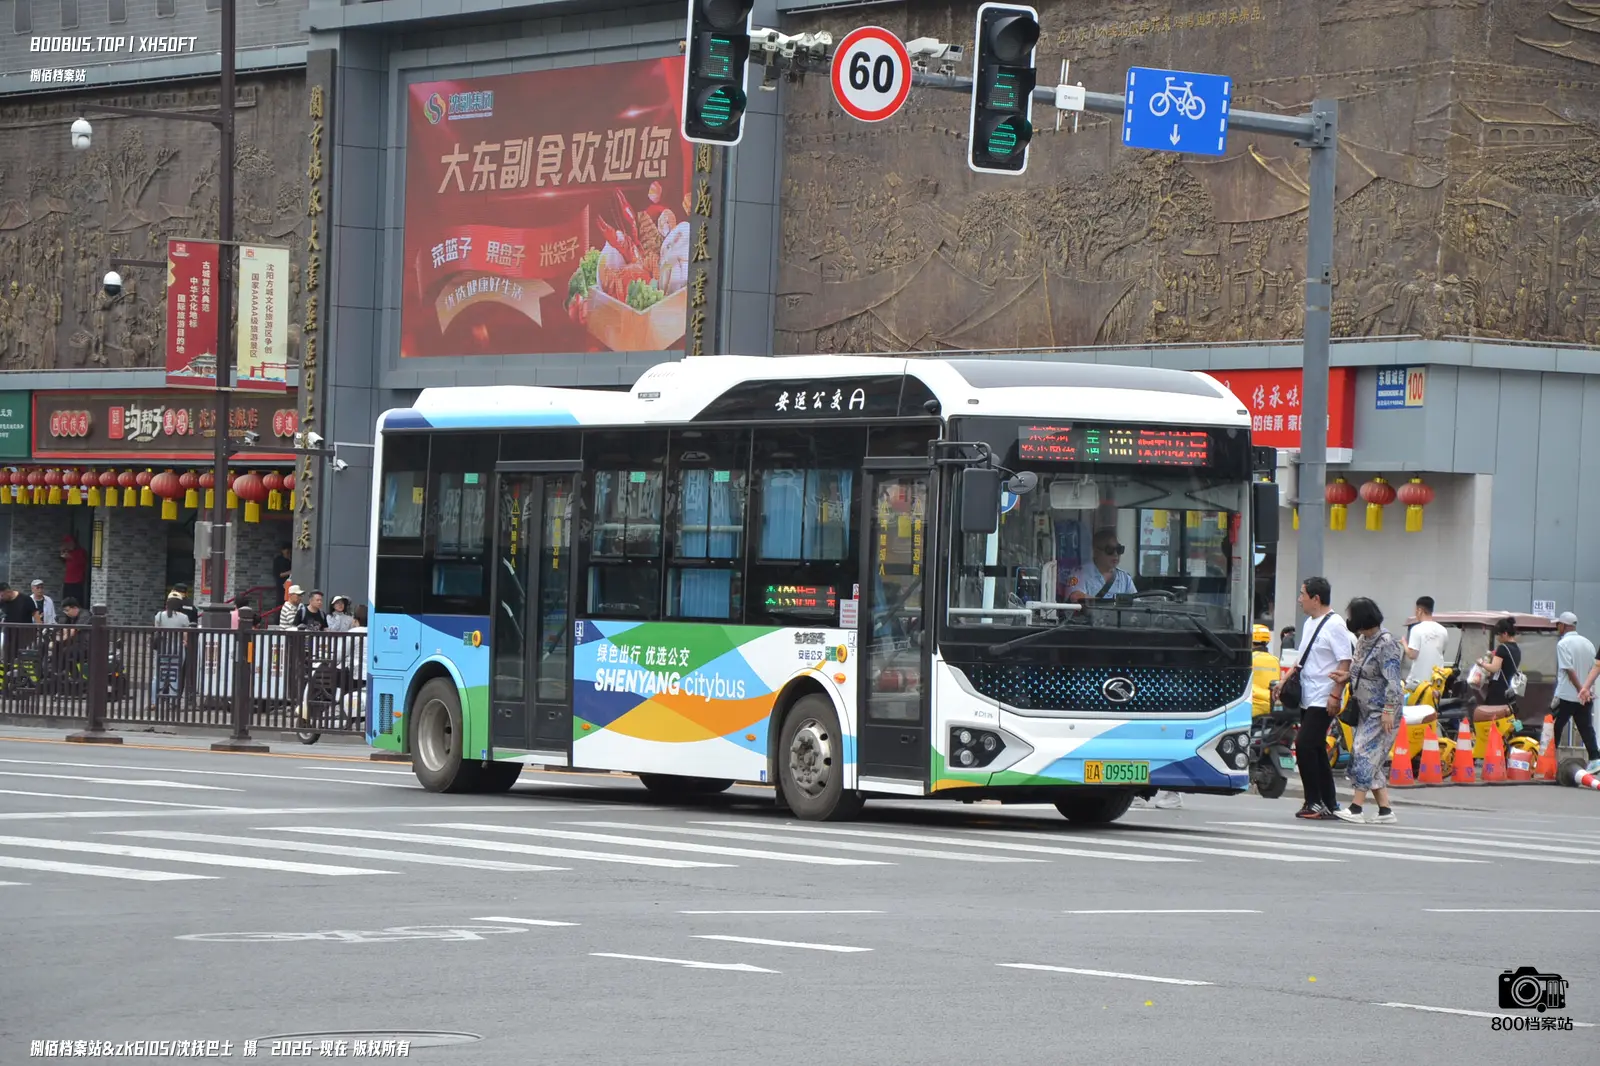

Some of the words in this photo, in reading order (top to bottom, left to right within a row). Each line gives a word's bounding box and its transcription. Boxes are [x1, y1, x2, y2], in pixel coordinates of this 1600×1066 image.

[848, 51, 895, 94] 60
[437, 125, 672, 194] 大东副食欢迎您
[431, 237, 472, 268] 菜篮子
[486, 240, 526, 267] 果盘子
[539, 236, 580, 267] 米袋子
[189, 276, 199, 328] 中华文化地标
[201, 260, 211, 313] 古城复兴典范
[445, 275, 525, 311] 优选健康好生活
[176, 293, 186, 354] 国际旅游目的地
[249, 272, 260, 358] 国家AAAAA级旅游景区
[263, 263, 275, 354] 沈阳方城文化旅游区争创
[1408, 372, 1424, 401] 100
[597, 643, 641, 666] 绿色出行
[645, 645, 690, 668] 优选公交
[798, 649, 823, 660] 安运公交
[594, 667, 681, 696] SHENYANG
[684, 671, 746, 702] citybus
[1104, 762, 1149, 782] 09551D
